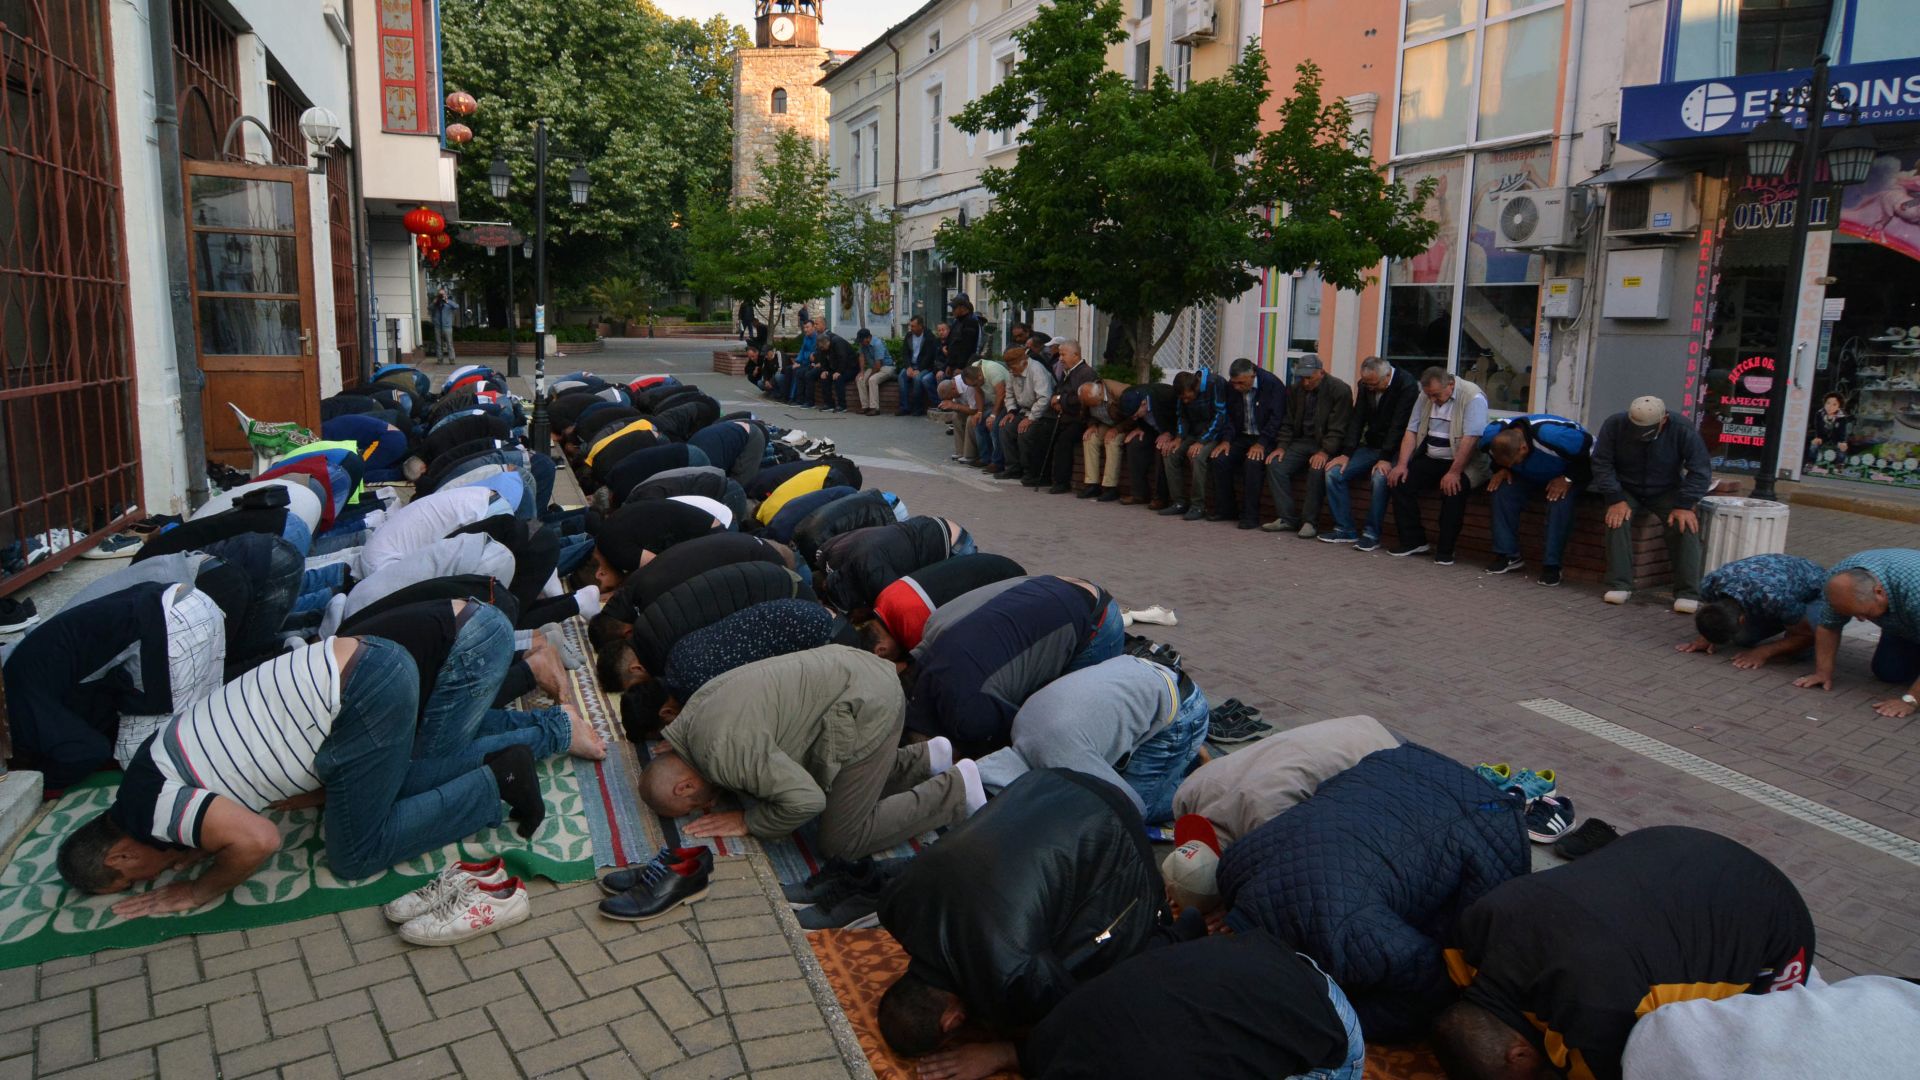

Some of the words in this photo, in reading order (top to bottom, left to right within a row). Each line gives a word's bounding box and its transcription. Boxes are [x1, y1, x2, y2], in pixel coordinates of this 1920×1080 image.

[1741, 117, 1802, 128] MEER
[1838, 108, 1920, 121] EROHOL
[1733, 197, 1830, 230] ОБУВИ
[1692, 229, 1713, 332] ДЕТСКИ
[1681, 340, 1699, 417] ОБУВ
[1728, 356, 1761, 384] ДЕТСКИ
[1719, 433, 1751, 445] НИСКИ
[1752, 436, 1766, 447] ЦЕ
